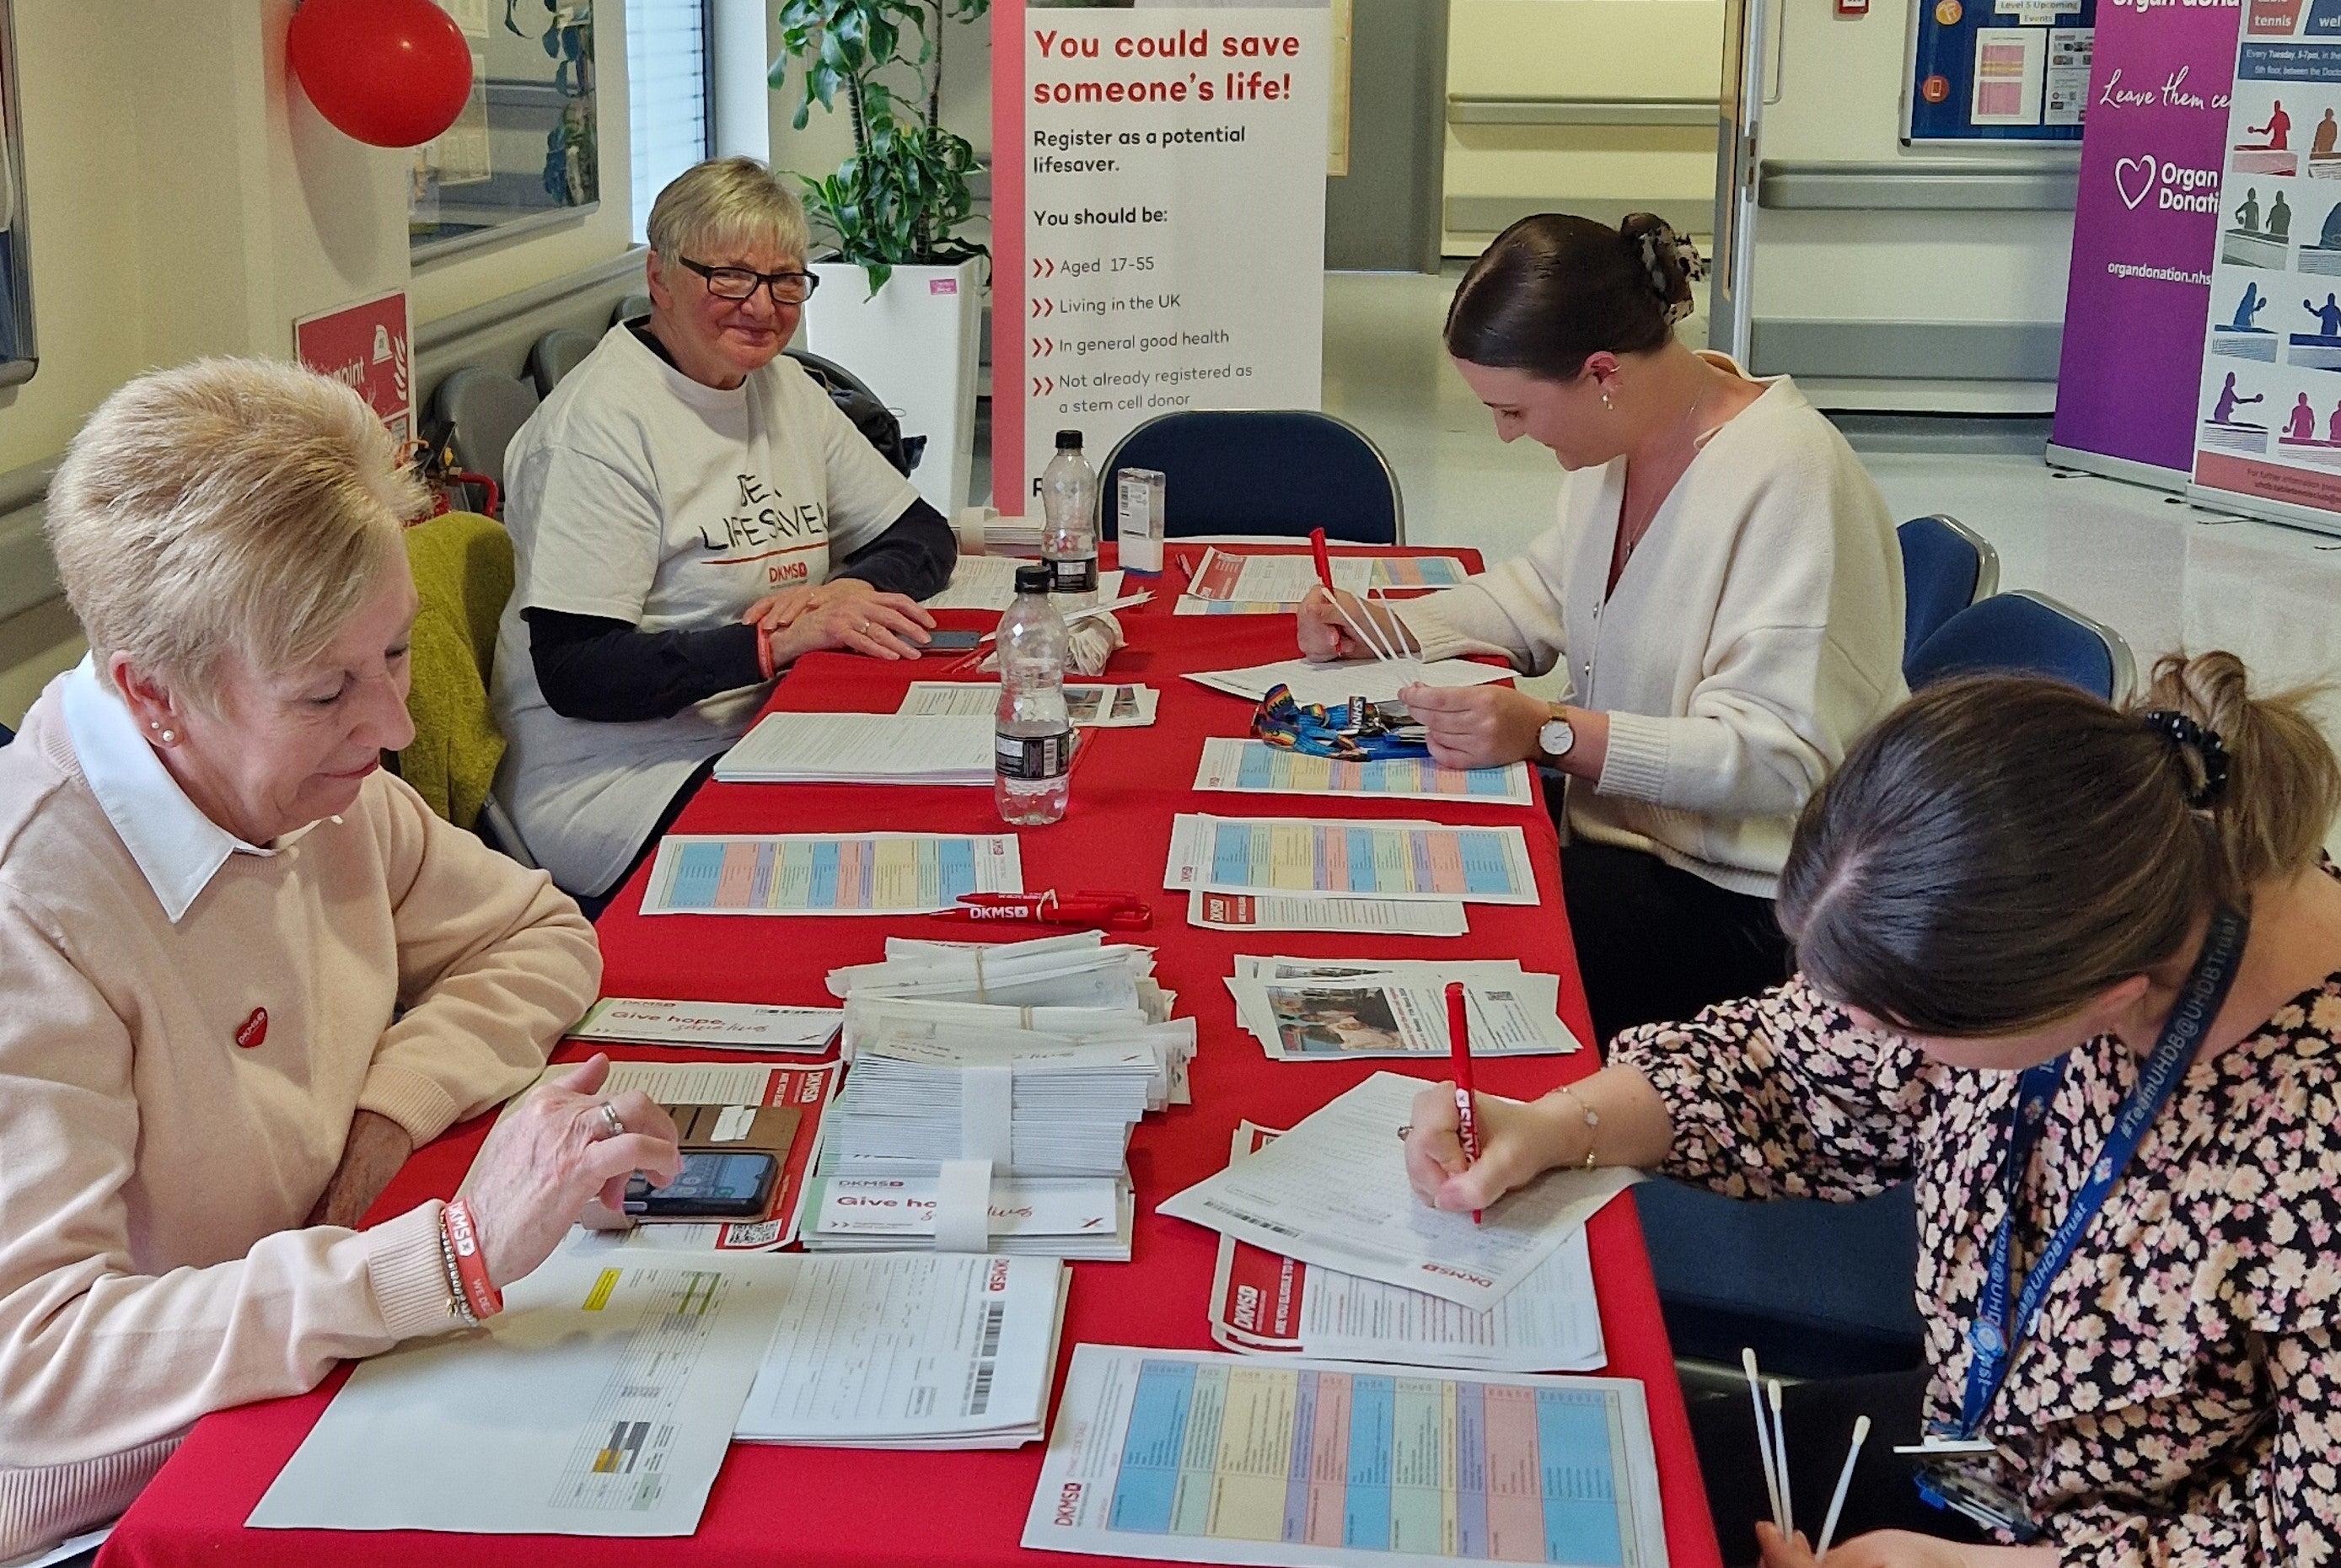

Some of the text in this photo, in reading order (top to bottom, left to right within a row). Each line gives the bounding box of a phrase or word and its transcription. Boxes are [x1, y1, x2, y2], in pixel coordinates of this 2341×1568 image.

[2254, 14, 2292, 27] tennis
[1034, 29, 1300, 59] You could save
[1034, 71, 1291, 104] someone's life!
[2100, 68, 2156, 109] Leave
[2161, 66, 2204, 110] them
[1034, 126, 1245, 151] Register as a potential
[1034, 156, 1120, 174] lifesaver.
[2161, 162, 2218, 190] Organ
[1034, 207, 1168, 227] You should be:
[1060, 256, 1155, 278] Aged 17-55
[1059, 293, 1180, 315] Living in the UK
[1059, 329, 1230, 356] In general good health
[1059, 363, 1253, 389] Not already registered as
[1059, 392, 1190, 414] a stem cell donor
[970, 906, 1015, 919] DKMS
[611, 1012, 662, 1021] Give
[837, 1195, 937, 1208] Give ho
[448, 1200, 472, 1240] DKMS
[1233, 1292, 1257, 1330] DKMS
[1054, 1490, 1080, 1527] DKMS
